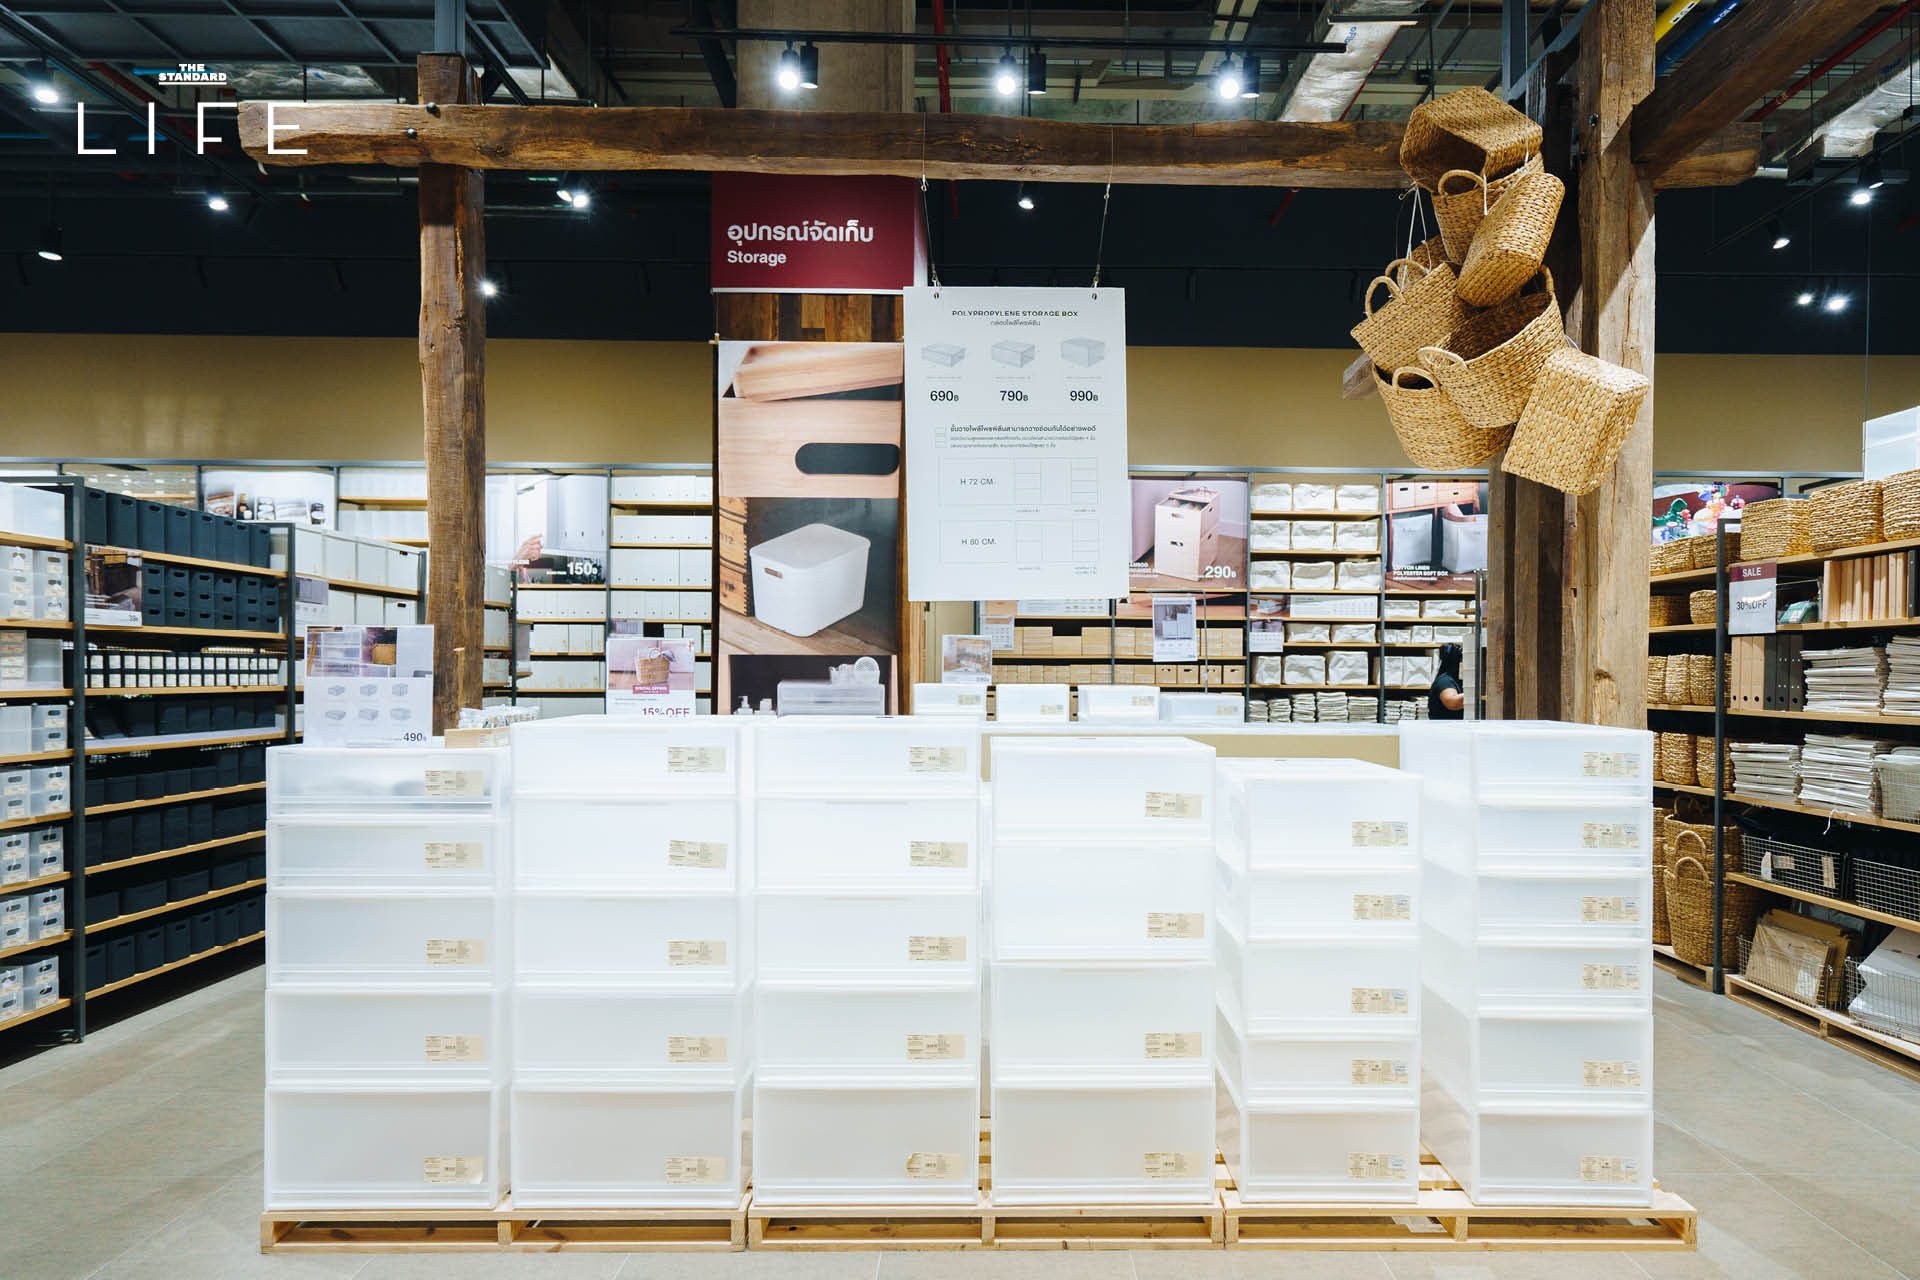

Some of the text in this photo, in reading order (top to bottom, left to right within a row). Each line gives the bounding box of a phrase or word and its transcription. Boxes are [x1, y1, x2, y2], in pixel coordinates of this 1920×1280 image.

[727, 219, 873, 247] อุปกรณ์จัดเก็บ
[727, 250, 787, 267] Storage
[1742, 567, 1762, 577] SALE
